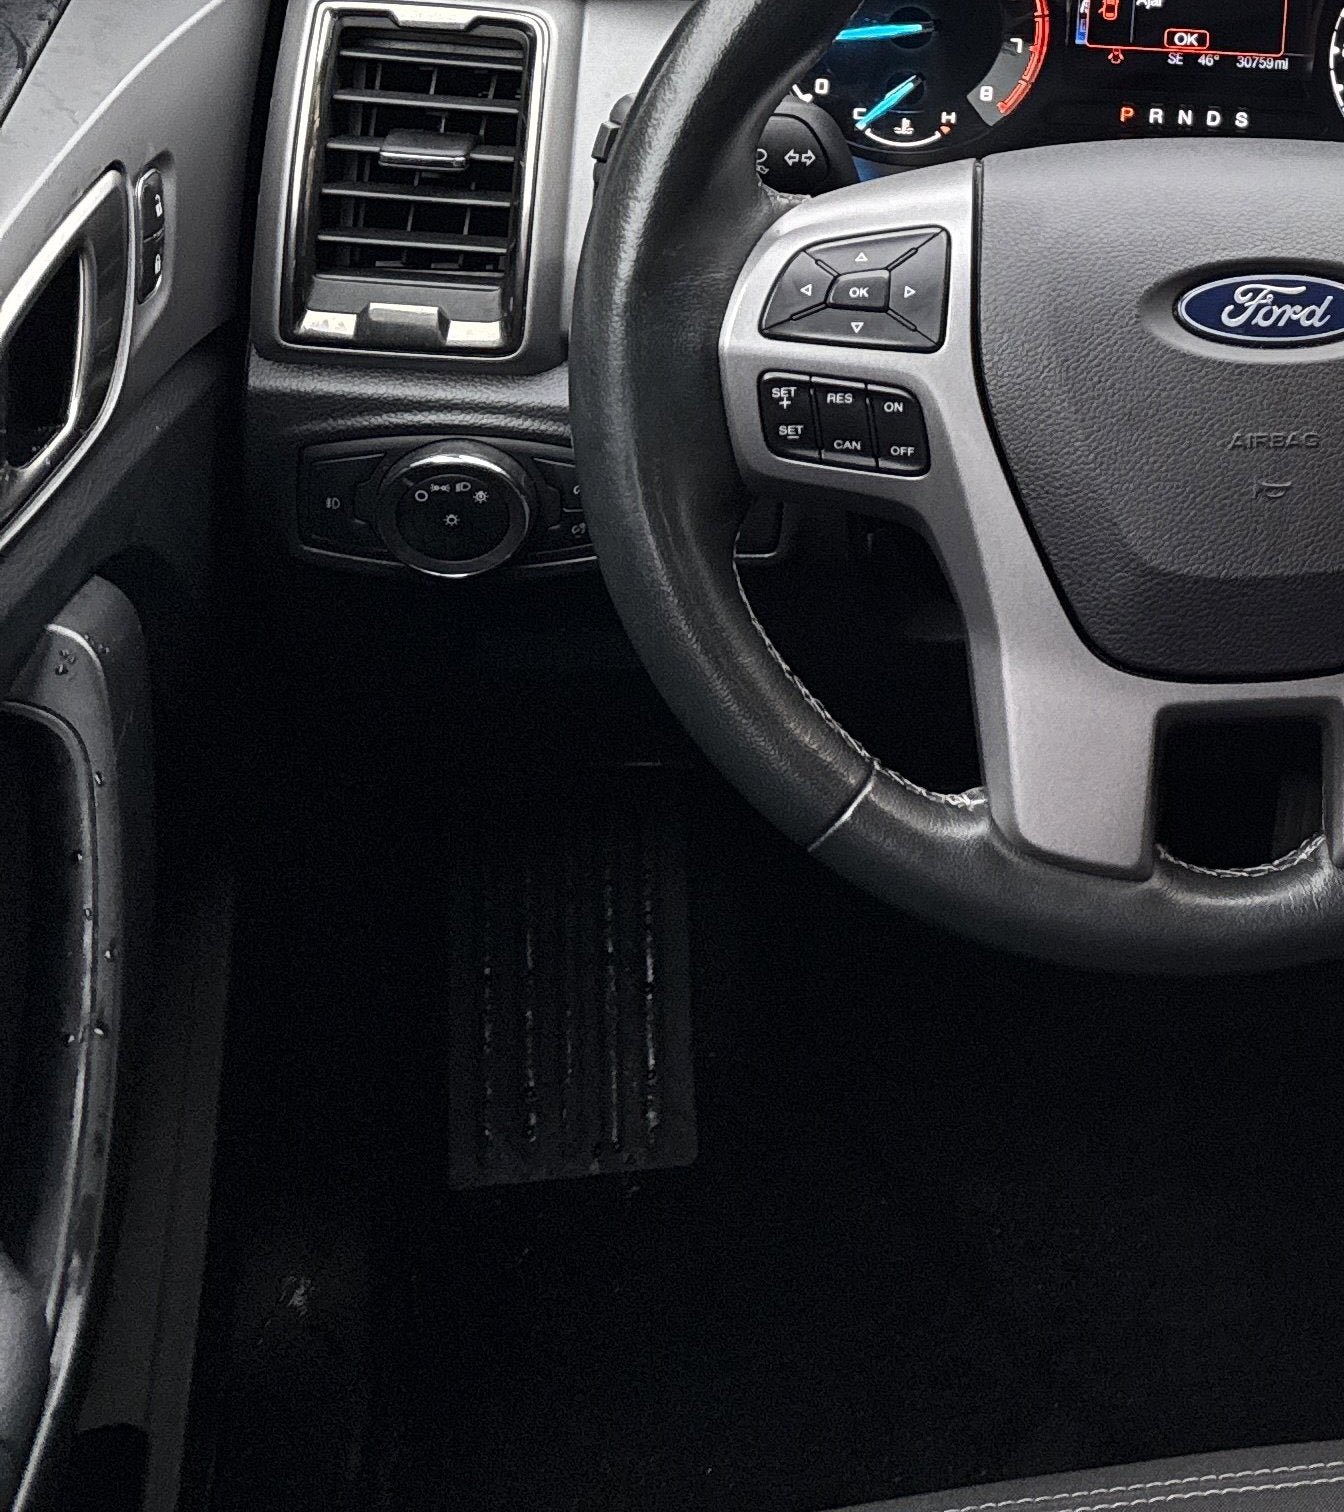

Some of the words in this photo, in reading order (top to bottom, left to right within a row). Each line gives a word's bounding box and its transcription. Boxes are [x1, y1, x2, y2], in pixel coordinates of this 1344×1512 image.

[1009, 37, 1024, 54] 7
[1173, 32, 1199, 47] OK
[1167, 52, 1184, 65] SE
[1198, 54, 1220, 67] 46°
[814, 78, 829, 95] 0
[979, 85, 994, 101] 8
[940, 111, 957, 124] H
[1119, 106, 1135, 122] P
[1149, 108, 1164, 124] R
[1177, 109, 1193, 126] N
[1206, 111, 1221, 126] D
[1234, 111, 1249, 127] S
[848, 286, 869, 299] OK
[1220, 283, 1333, 330] Ford
[771, 386, 797, 399] SET
[826, 392, 853, 405] RES
[883, 401, 904, 413] ON
[778, 424, 804, 436] SET
[833, 439, 862, 452] CAN
[1225, 431, 1321, 450] AIRBAG
[889, 445, 915, 457] OFF
